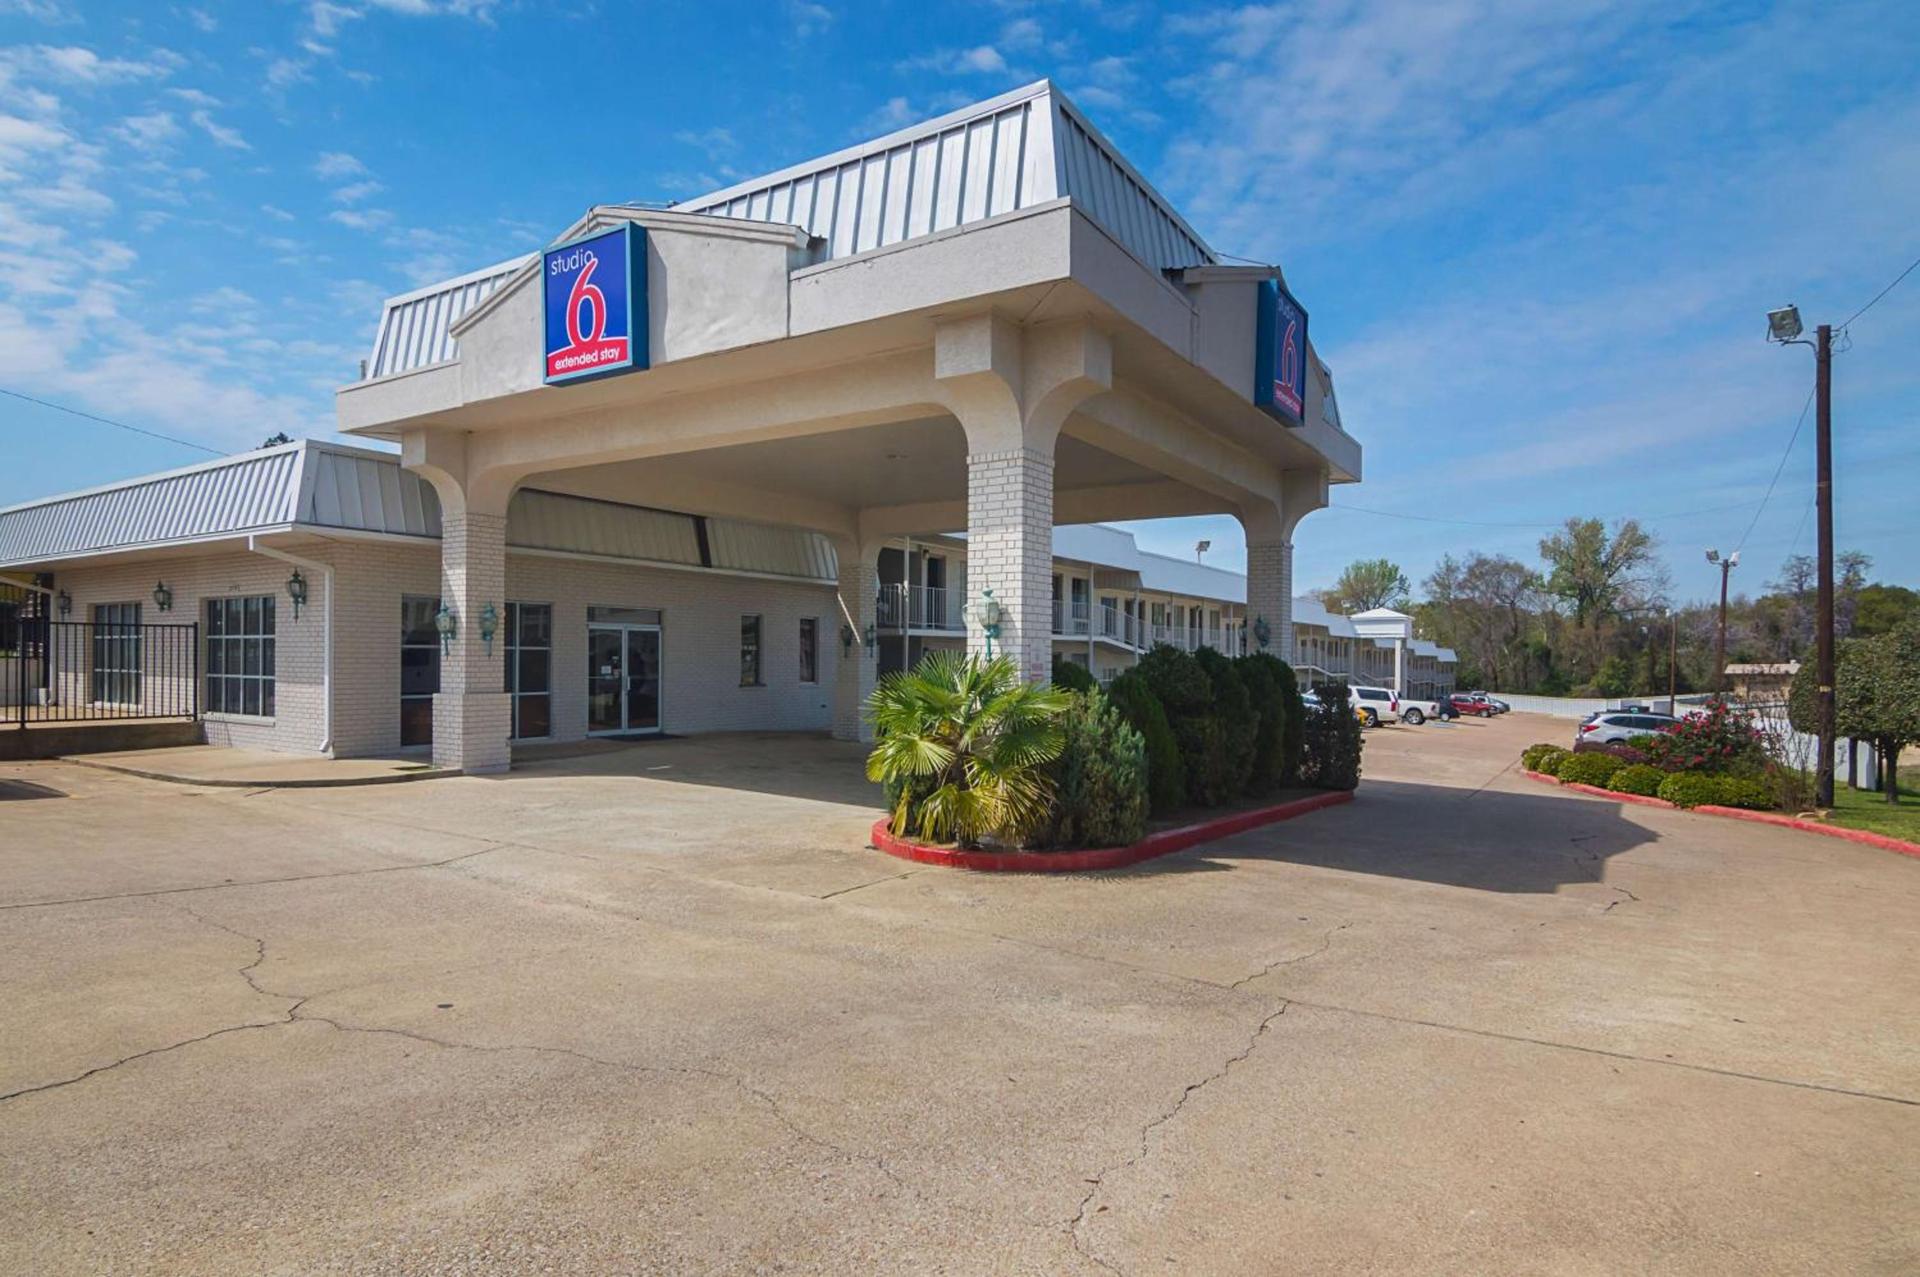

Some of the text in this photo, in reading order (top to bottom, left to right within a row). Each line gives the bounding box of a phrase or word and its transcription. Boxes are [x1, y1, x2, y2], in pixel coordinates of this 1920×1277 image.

[551, 248, 593, 275] studio
[566, 258, 607, 347] 6
[555, 347, 620, 370] extended stay
[1282, 320, 1297, 391] 6
